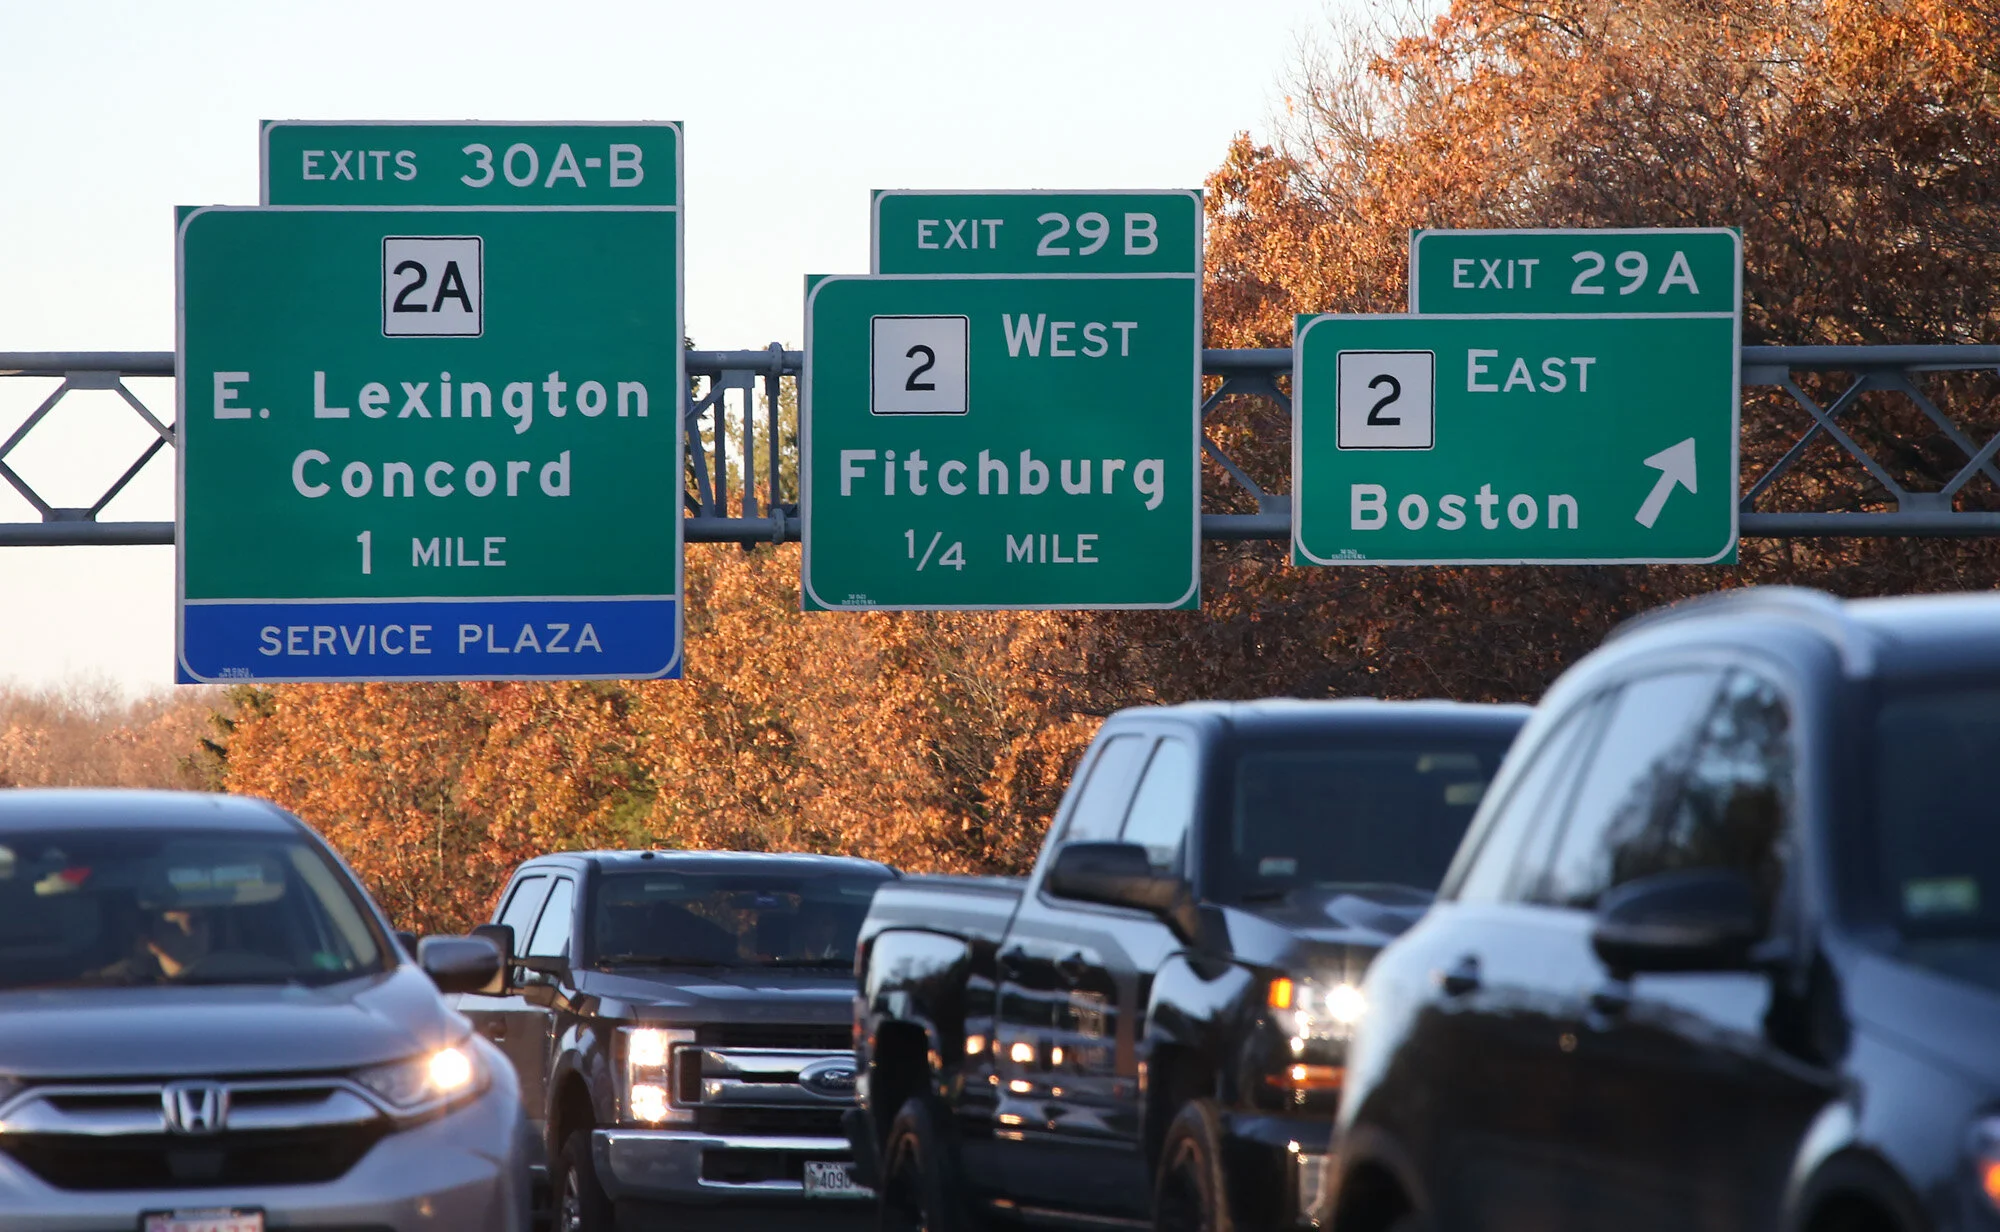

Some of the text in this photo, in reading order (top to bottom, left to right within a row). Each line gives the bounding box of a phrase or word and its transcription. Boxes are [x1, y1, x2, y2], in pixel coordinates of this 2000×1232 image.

[303, 143, 644, 188] EXITS 30A-B
[917, 212, 1159, 257] EXIT 29B
[392, 260, 474, 313] 2A
[1453, 251, 1700, 296] EXIT 29A
[1002, 313, 1138, 358] WEST
[905, 344, 936, 391] 2
[1467, 348, 1596, 393] EAST
[213, 370, 649, 435] E. Lexington
[1366, 374, 1402, 426] 2
[291, 449, 571, 498] Concord
[840, 448, 1164, 511] Fitchburg
[1350, 483, 1578, 531] Boston
[357, 530, 506, 575] 1 MILE
[904, 529, 1099, 571] 1/4 MILE
[258, 623, 603, 656] SERVICE PLAZA
